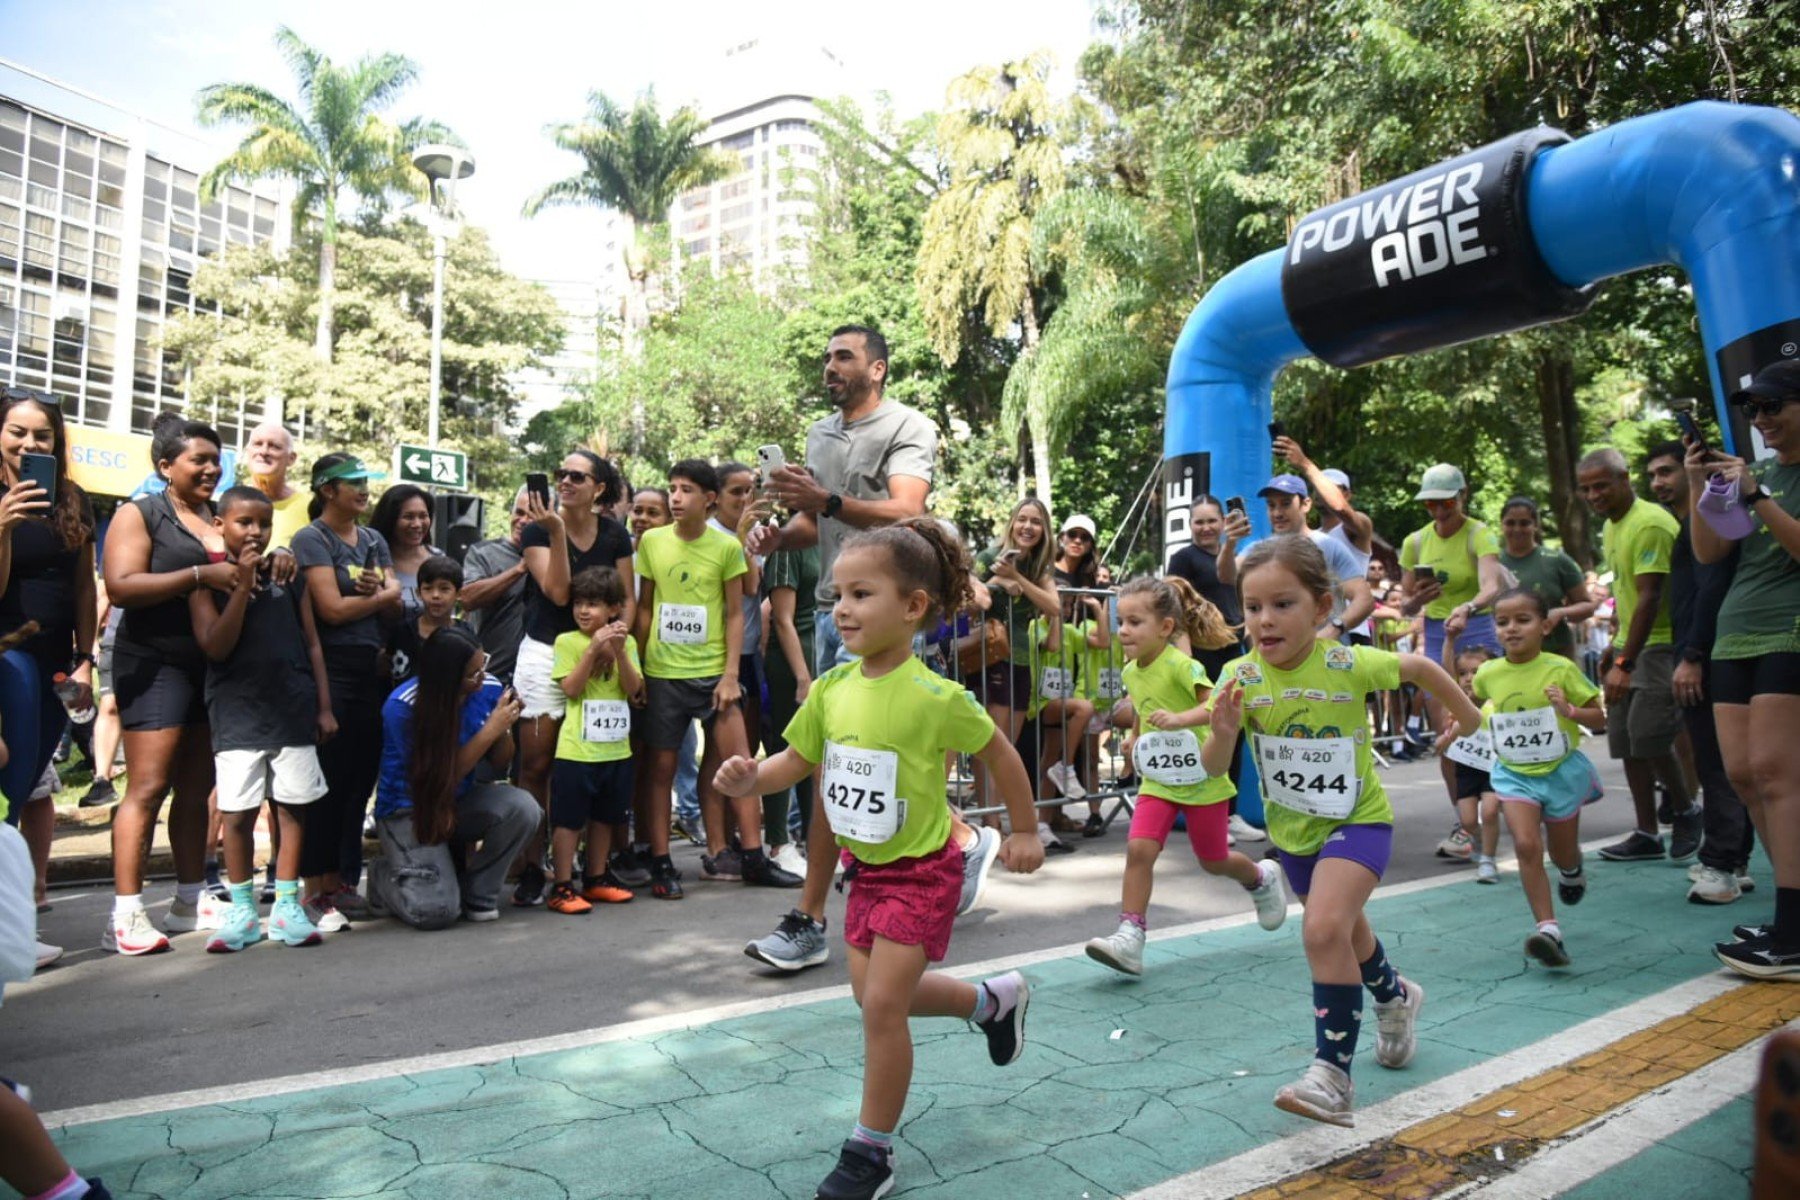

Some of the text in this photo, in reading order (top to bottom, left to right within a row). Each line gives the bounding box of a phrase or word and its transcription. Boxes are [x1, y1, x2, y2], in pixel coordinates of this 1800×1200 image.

[1291, 161, 1484, 266] POWER
[71, 446, 128, 469] SESC
[665, 621, 702, 634] 4049
[592, 717, 628, 729] 4173
[1455, 740, 1492, 760] 4241
[1503, 731, 1554, 749] 4247
[1146, 752, 1198, 770] 4266
[1272, 769, 1348, 795] 4244
[827, 781, 886, 815] 4275
